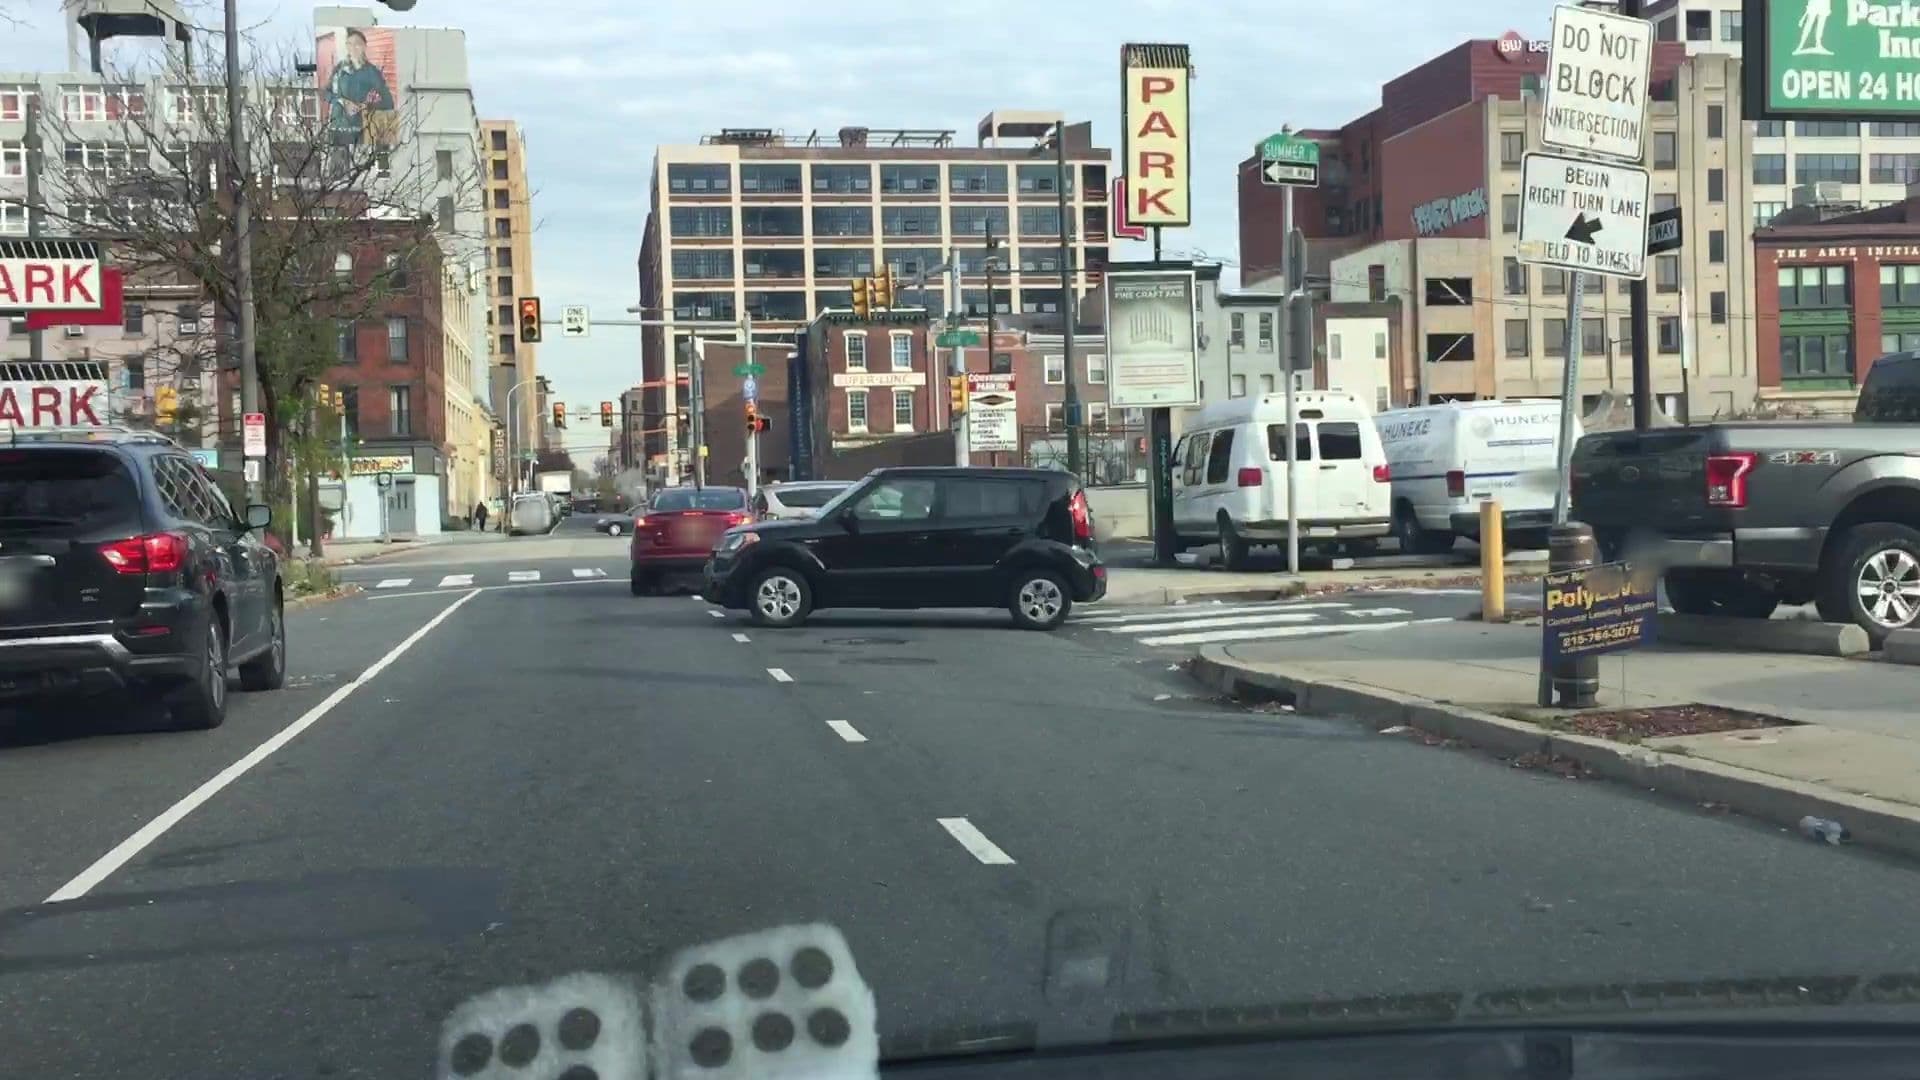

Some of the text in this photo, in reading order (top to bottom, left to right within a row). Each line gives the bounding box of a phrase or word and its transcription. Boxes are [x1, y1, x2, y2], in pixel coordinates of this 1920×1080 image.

[1562, 23, 1641, 62] DO NOT
[1557, 62, 1637, 106] BLOCK
[1782, 68, 1851, 99] OPEN
[1858, 71, 1888, 100] 24
[1548, 106, 1638, 141] INTERSECTION
[1137, 75, 1178, 217] PARK
[1264, 142, 1305, 160] SUMMER
[1565, 167, 1609, 188] BEGIN
[1528, 185, 1641, 218] RIGHT TURN LANE
[1653, 221, 1675, 240] WAY
[1535, 240, 1569, 261] IELD
[1576, 244, 1590, 264] TO
[1596, 249, 1630, 267] BIKES
[1776, 249, 1807, 258] THE
[1818, 247, 1857, 257] ARTS
[0, 385, 102, 427] ARK
[1384, 419, 1431, 439] HUNEKE
